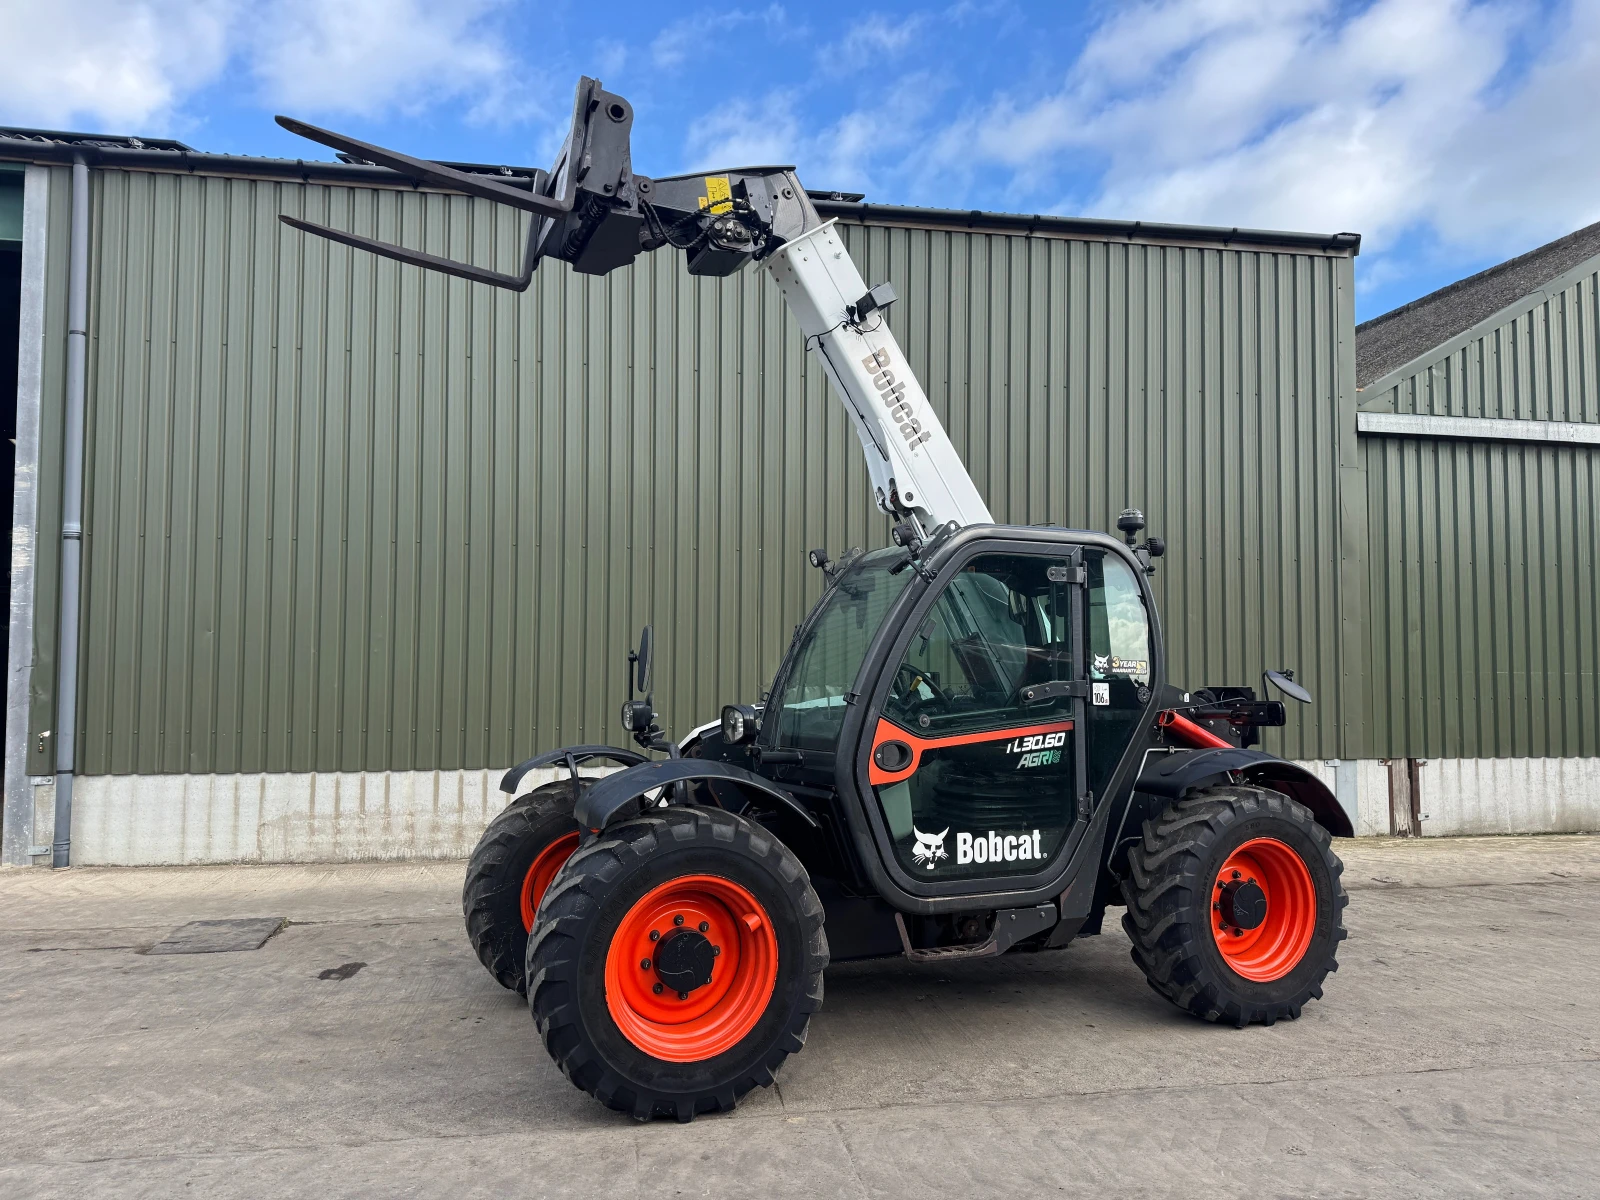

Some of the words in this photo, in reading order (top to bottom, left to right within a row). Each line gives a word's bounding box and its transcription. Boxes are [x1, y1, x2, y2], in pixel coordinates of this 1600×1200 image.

[861, 346, 932, 452] Bobcat
[1112, 656, 1120, 668] 3
[1120, 660, 1137, 668] YEAR
[1094, 692, 1105, 704] 106
[1016, 750, 1054, 769] AGRI
[956, 829, 1041, 865] Bobcat
